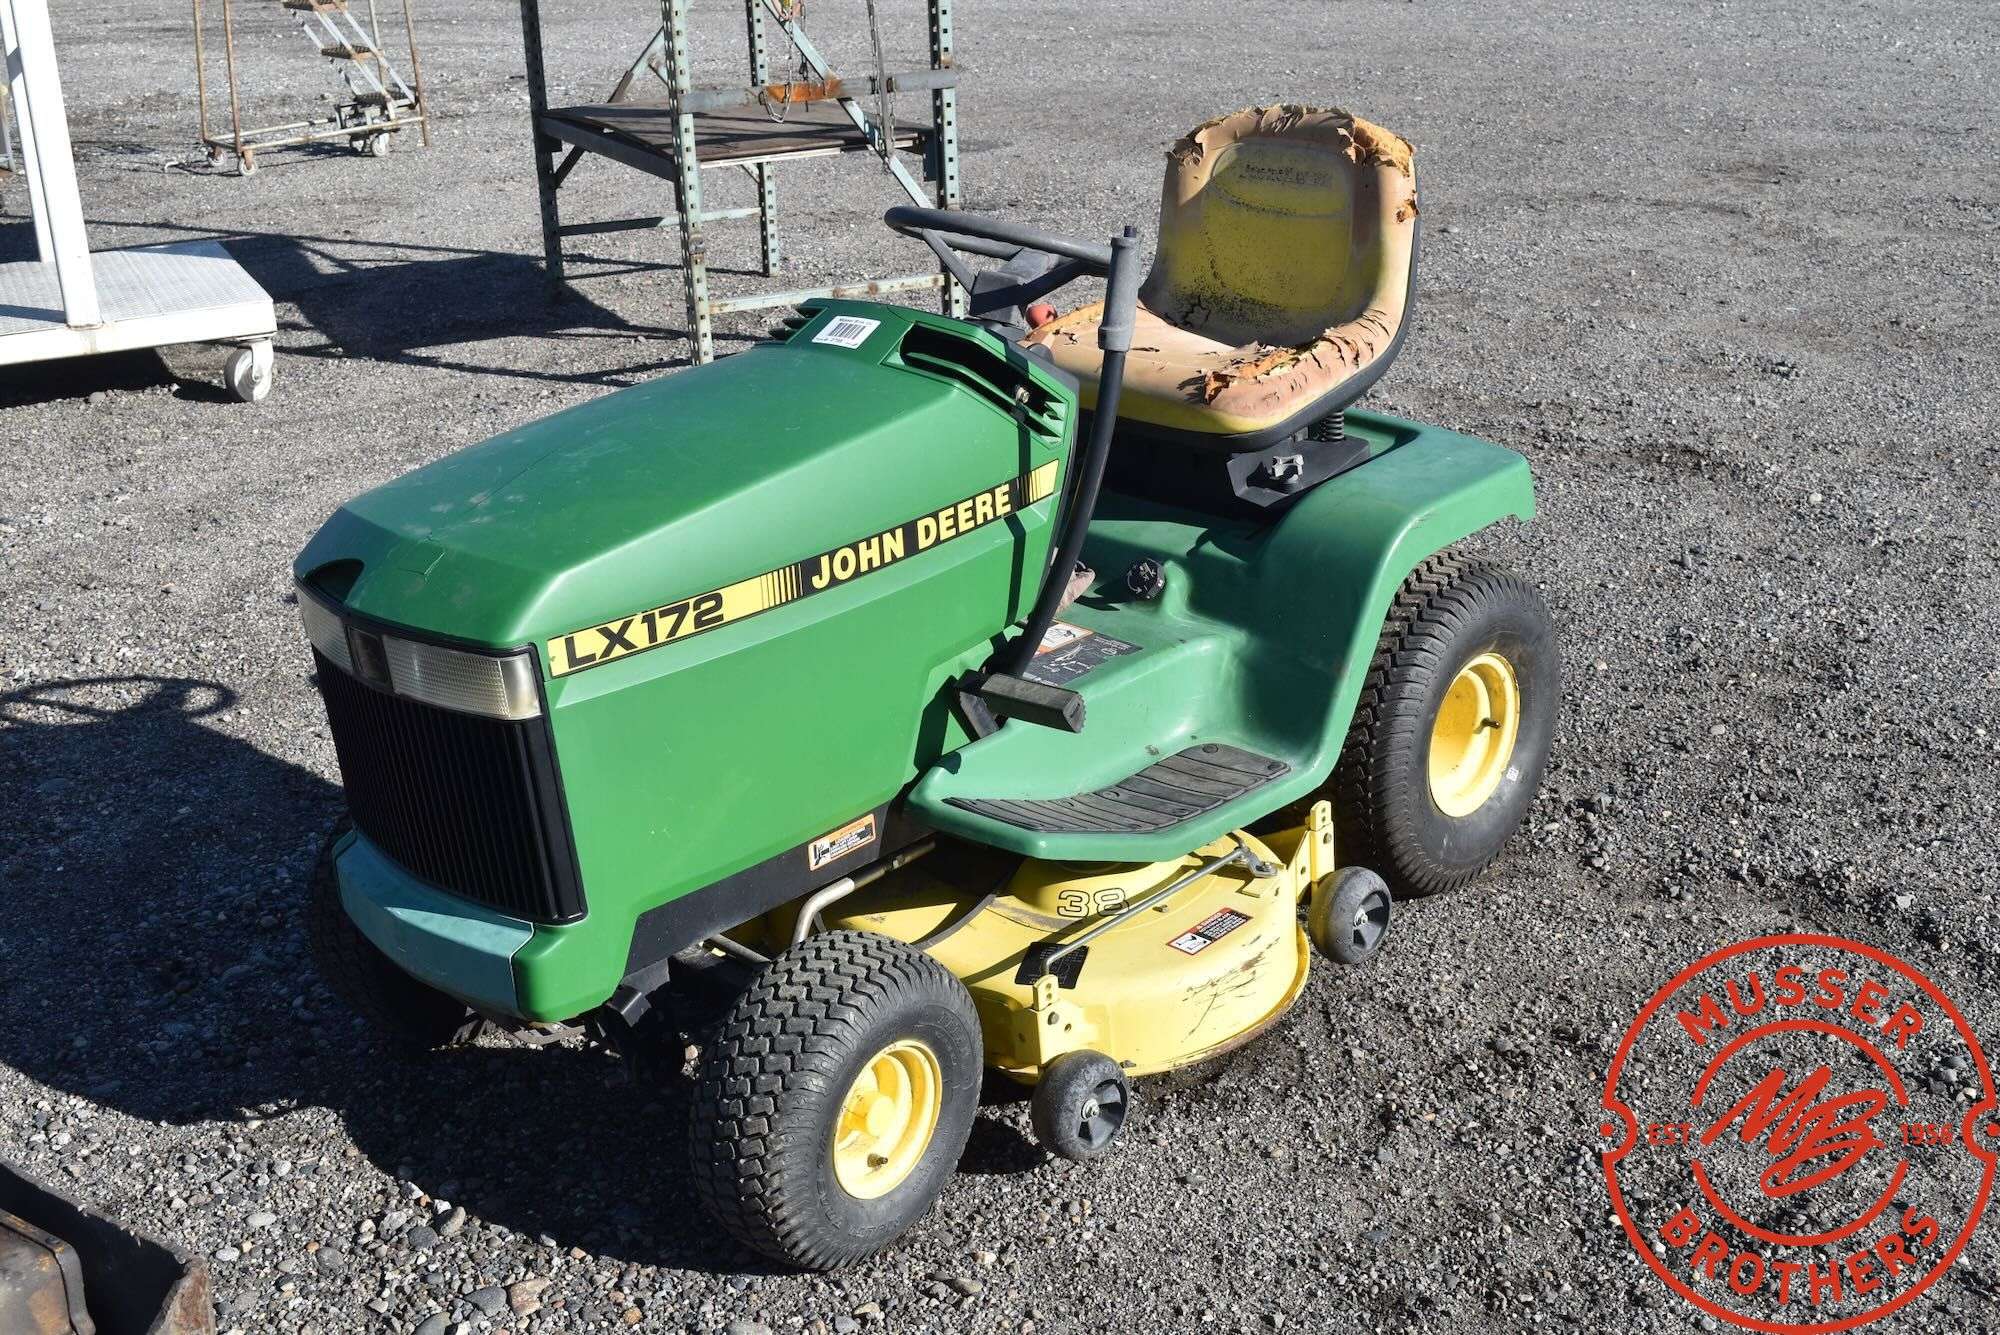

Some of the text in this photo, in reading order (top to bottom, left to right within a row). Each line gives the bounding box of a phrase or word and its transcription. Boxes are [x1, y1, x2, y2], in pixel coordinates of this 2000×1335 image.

[564, 483, 1012, 669] LX172 JOHN DEERE
[1057, 887, 1130, 918] 38
